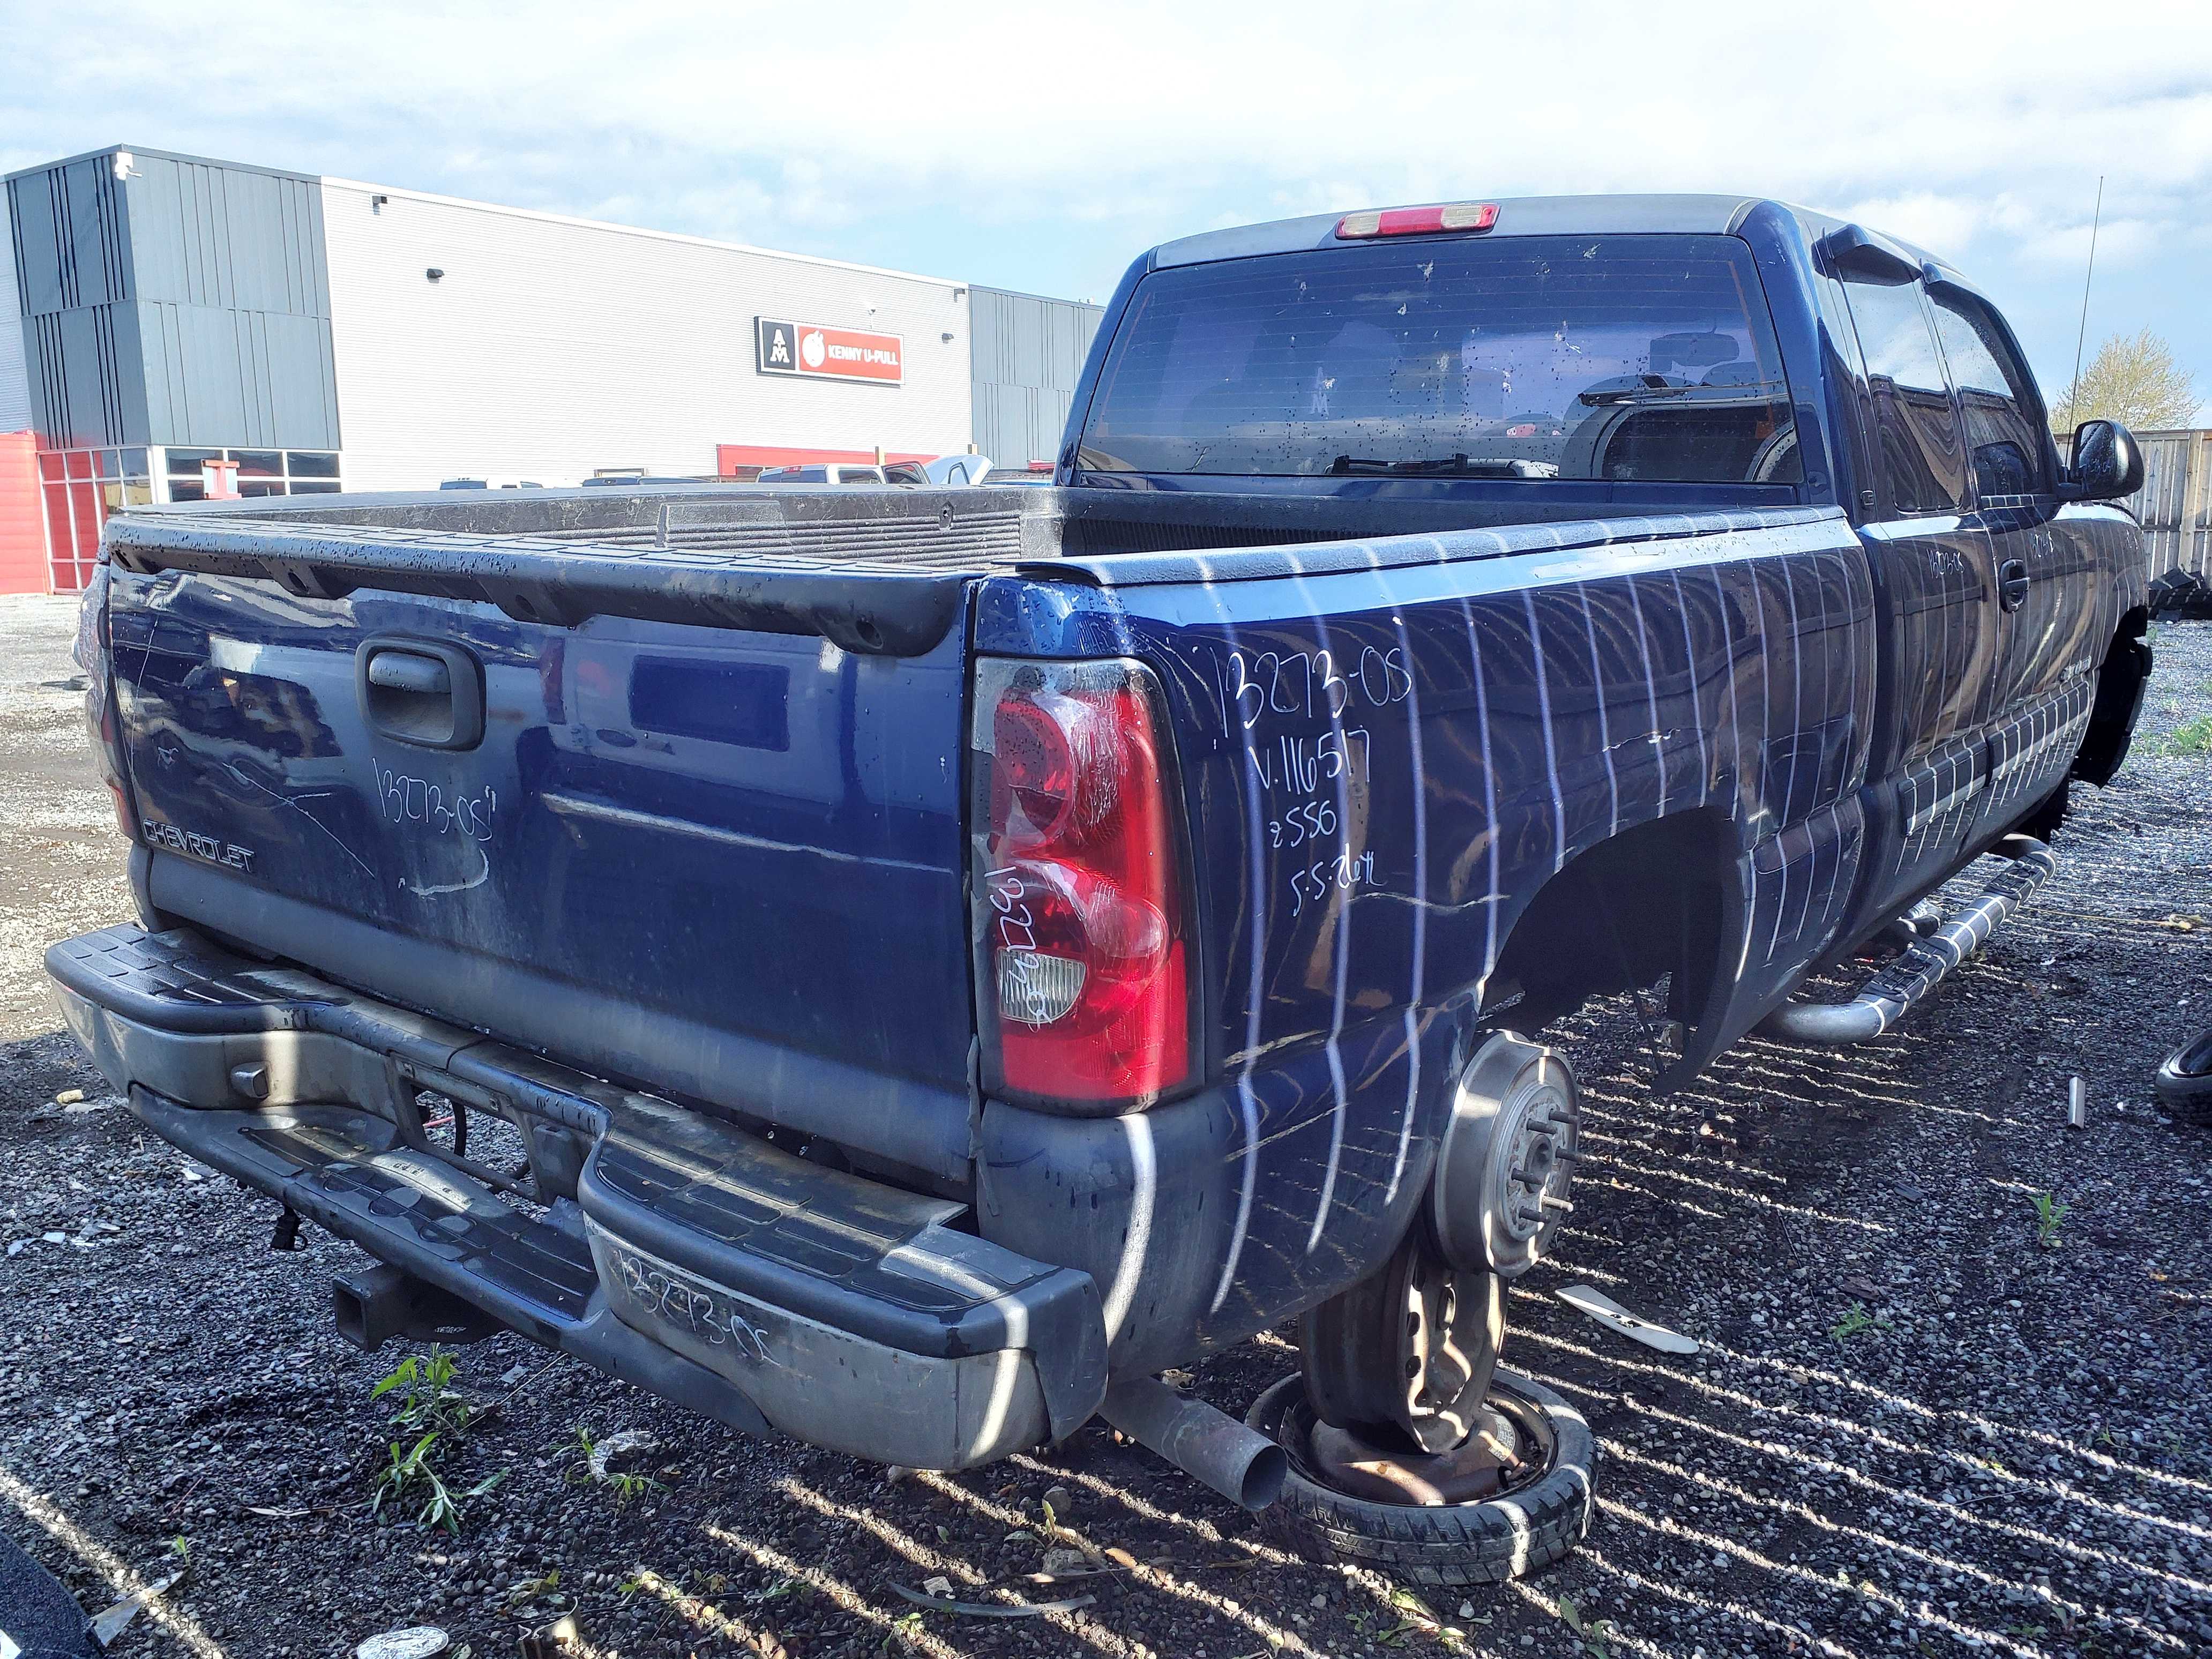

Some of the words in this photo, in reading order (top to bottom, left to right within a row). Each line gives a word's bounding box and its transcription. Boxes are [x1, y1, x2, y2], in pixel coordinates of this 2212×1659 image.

[827, 344, 862, 362] KENNY
[863, 347, 899, 366] U-PULL
[141, 819, 255, 873] CHEVROLET
